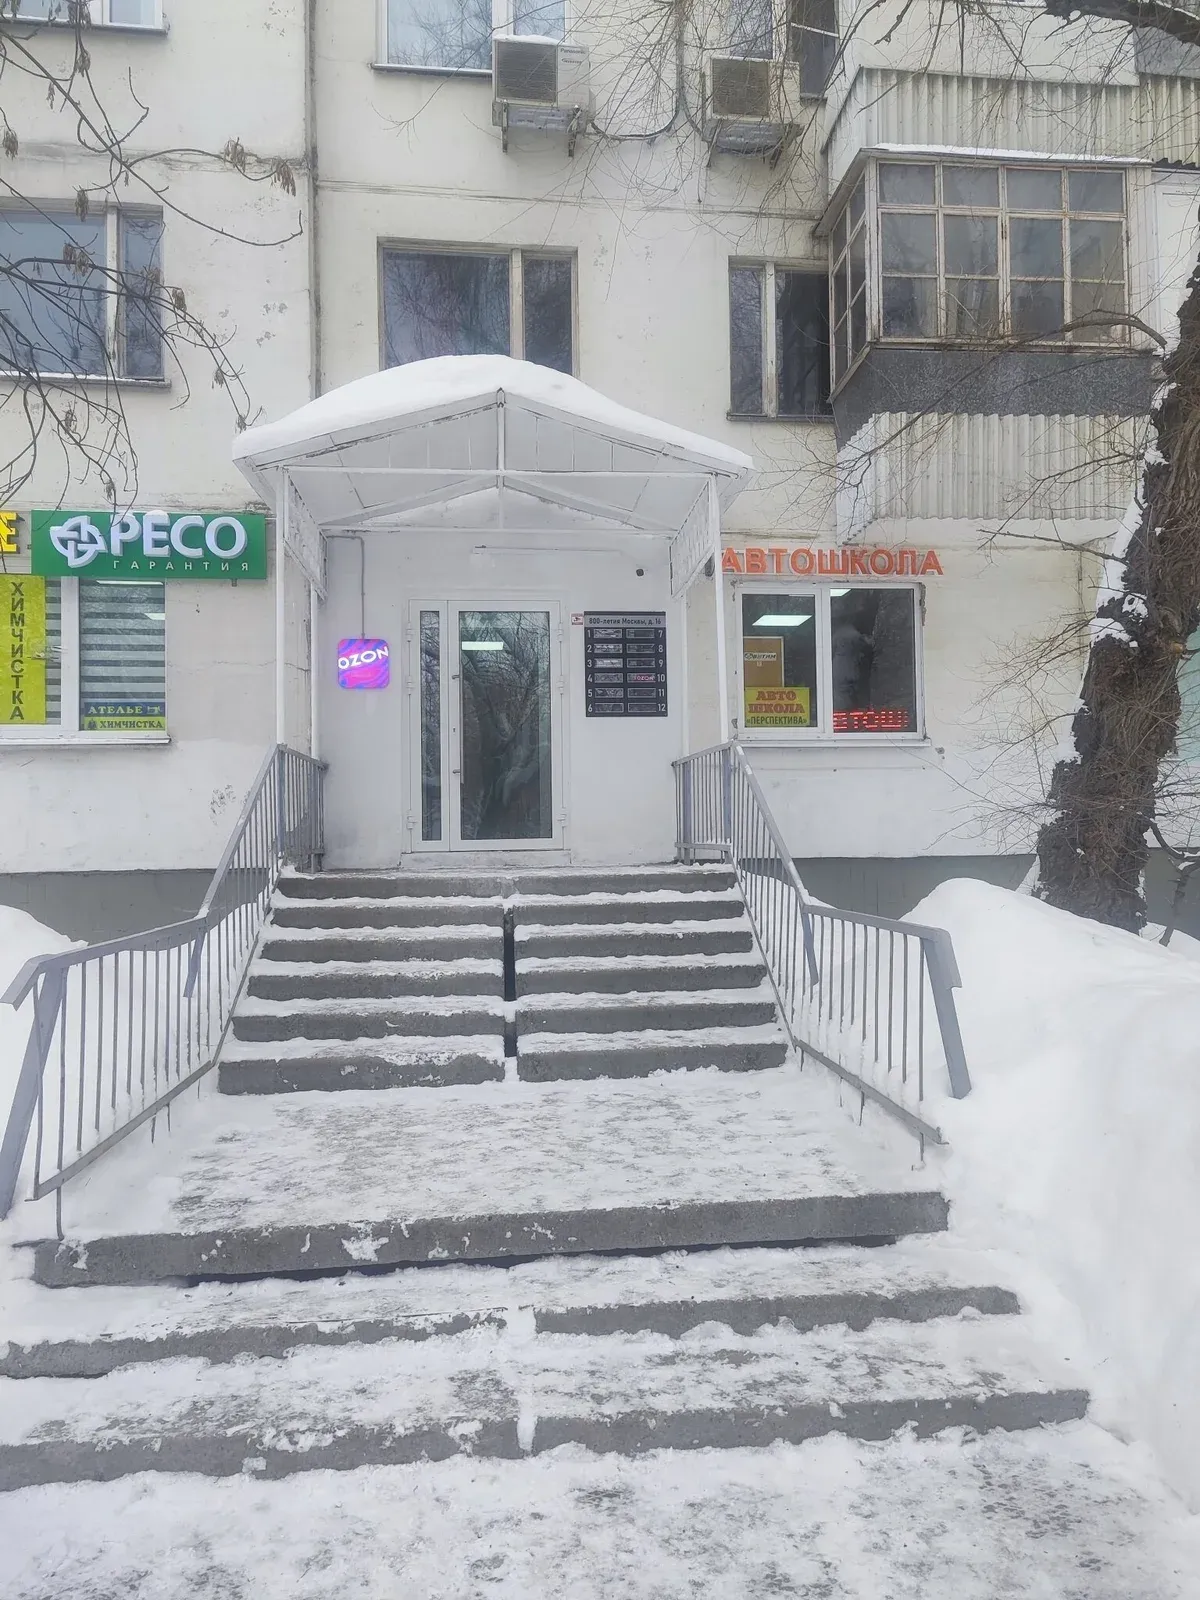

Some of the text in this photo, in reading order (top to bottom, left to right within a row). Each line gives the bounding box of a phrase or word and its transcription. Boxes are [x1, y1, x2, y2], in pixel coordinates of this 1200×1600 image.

[109, 511, 248, 559] РЕСО
[113, 560, 250, 571] ГАРАНТИЯ
[721, 547, 944, 576] АВТОШКОЛА
[588, 617, 621, 625] 800-летия
[621, 618, 647, 626] Москвы,
[655, 617, 662, 625] 16
[658, 630, 664, 638] 7
[10, 581, 26, 721] ХИМЧИСТКА
[658, 644, 664, 652] 8
[338, 646, 389, 669] OZON
[658, 659, 664, 668] 9
[657, 674, 665, 682] 10
[658, 689, 665, 697] 11
[756, 690, 797, 701] АВТО
[87, 705, 143, 714] АТЕЛЬЕ
[657, 703, 666, 712] 12
[748, 703, 806, 714] ШКОЛА
[99, 720, 164, 729] ХИМЧИСТКА
[746, 715, 808, 725] «ПЕРСПЕКТИВА»
